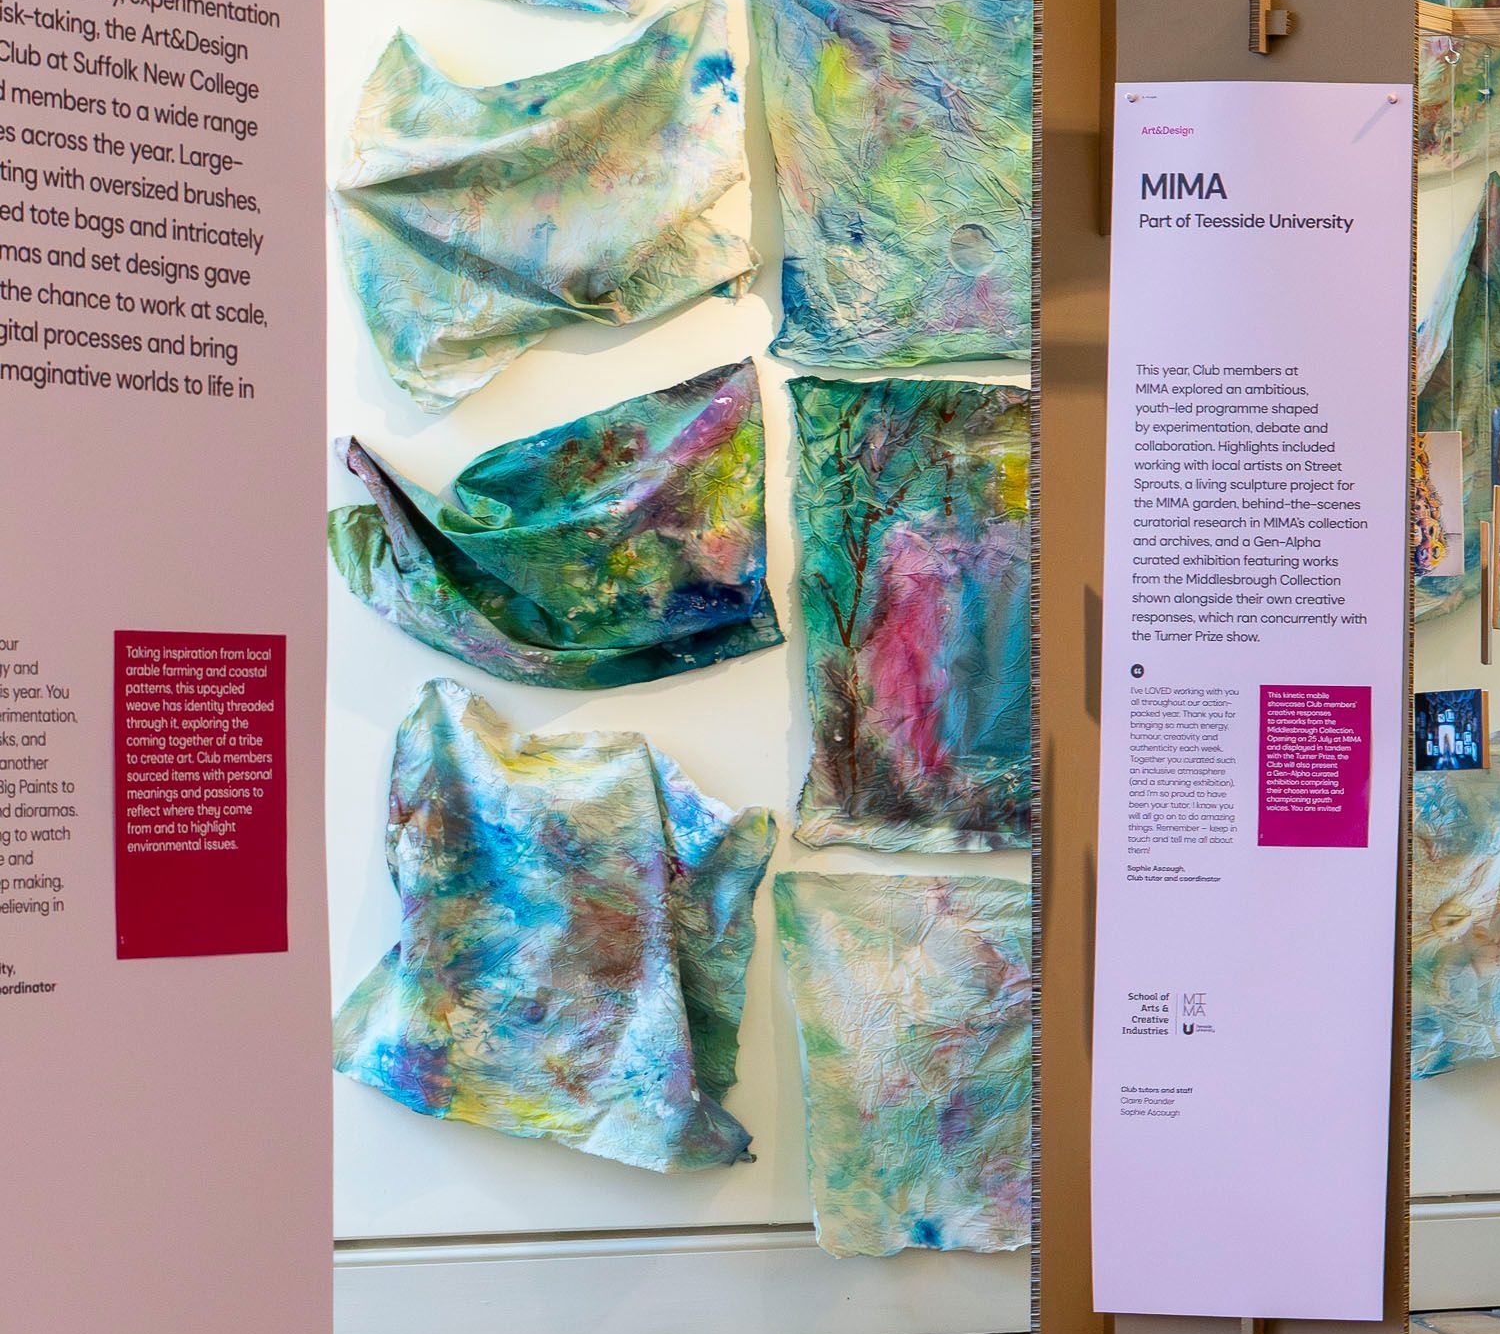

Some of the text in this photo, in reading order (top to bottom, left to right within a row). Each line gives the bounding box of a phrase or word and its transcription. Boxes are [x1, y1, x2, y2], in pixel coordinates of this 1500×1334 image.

[104, 18, 136, 42] the
[141, 23, 248, 64] Art&Design
[46, 51, 68, 71] at
[73, 51, 139, 82] Suffolk
[144, 61, 186, 88] New
[190, 69, 260, 104] College
[1141, 125, 1194, 137] Art&Design
[1141, 172, 1228, 200] MIMA
[1139, 213, 1354, 234] Part of Teesside University
[1136, 364, 1160, 376] This
[1192, 364, 1221, 376] Club
[1223, 364, 1282, 376] members
[1284, 366, 1299, 376] at
[1136, 383, 1309, 397] MIMA explored an ambitious,
[126, 645, 272, 662] Taking inspiration from local
[125, 663, 267, 681] arable farming and coastal
